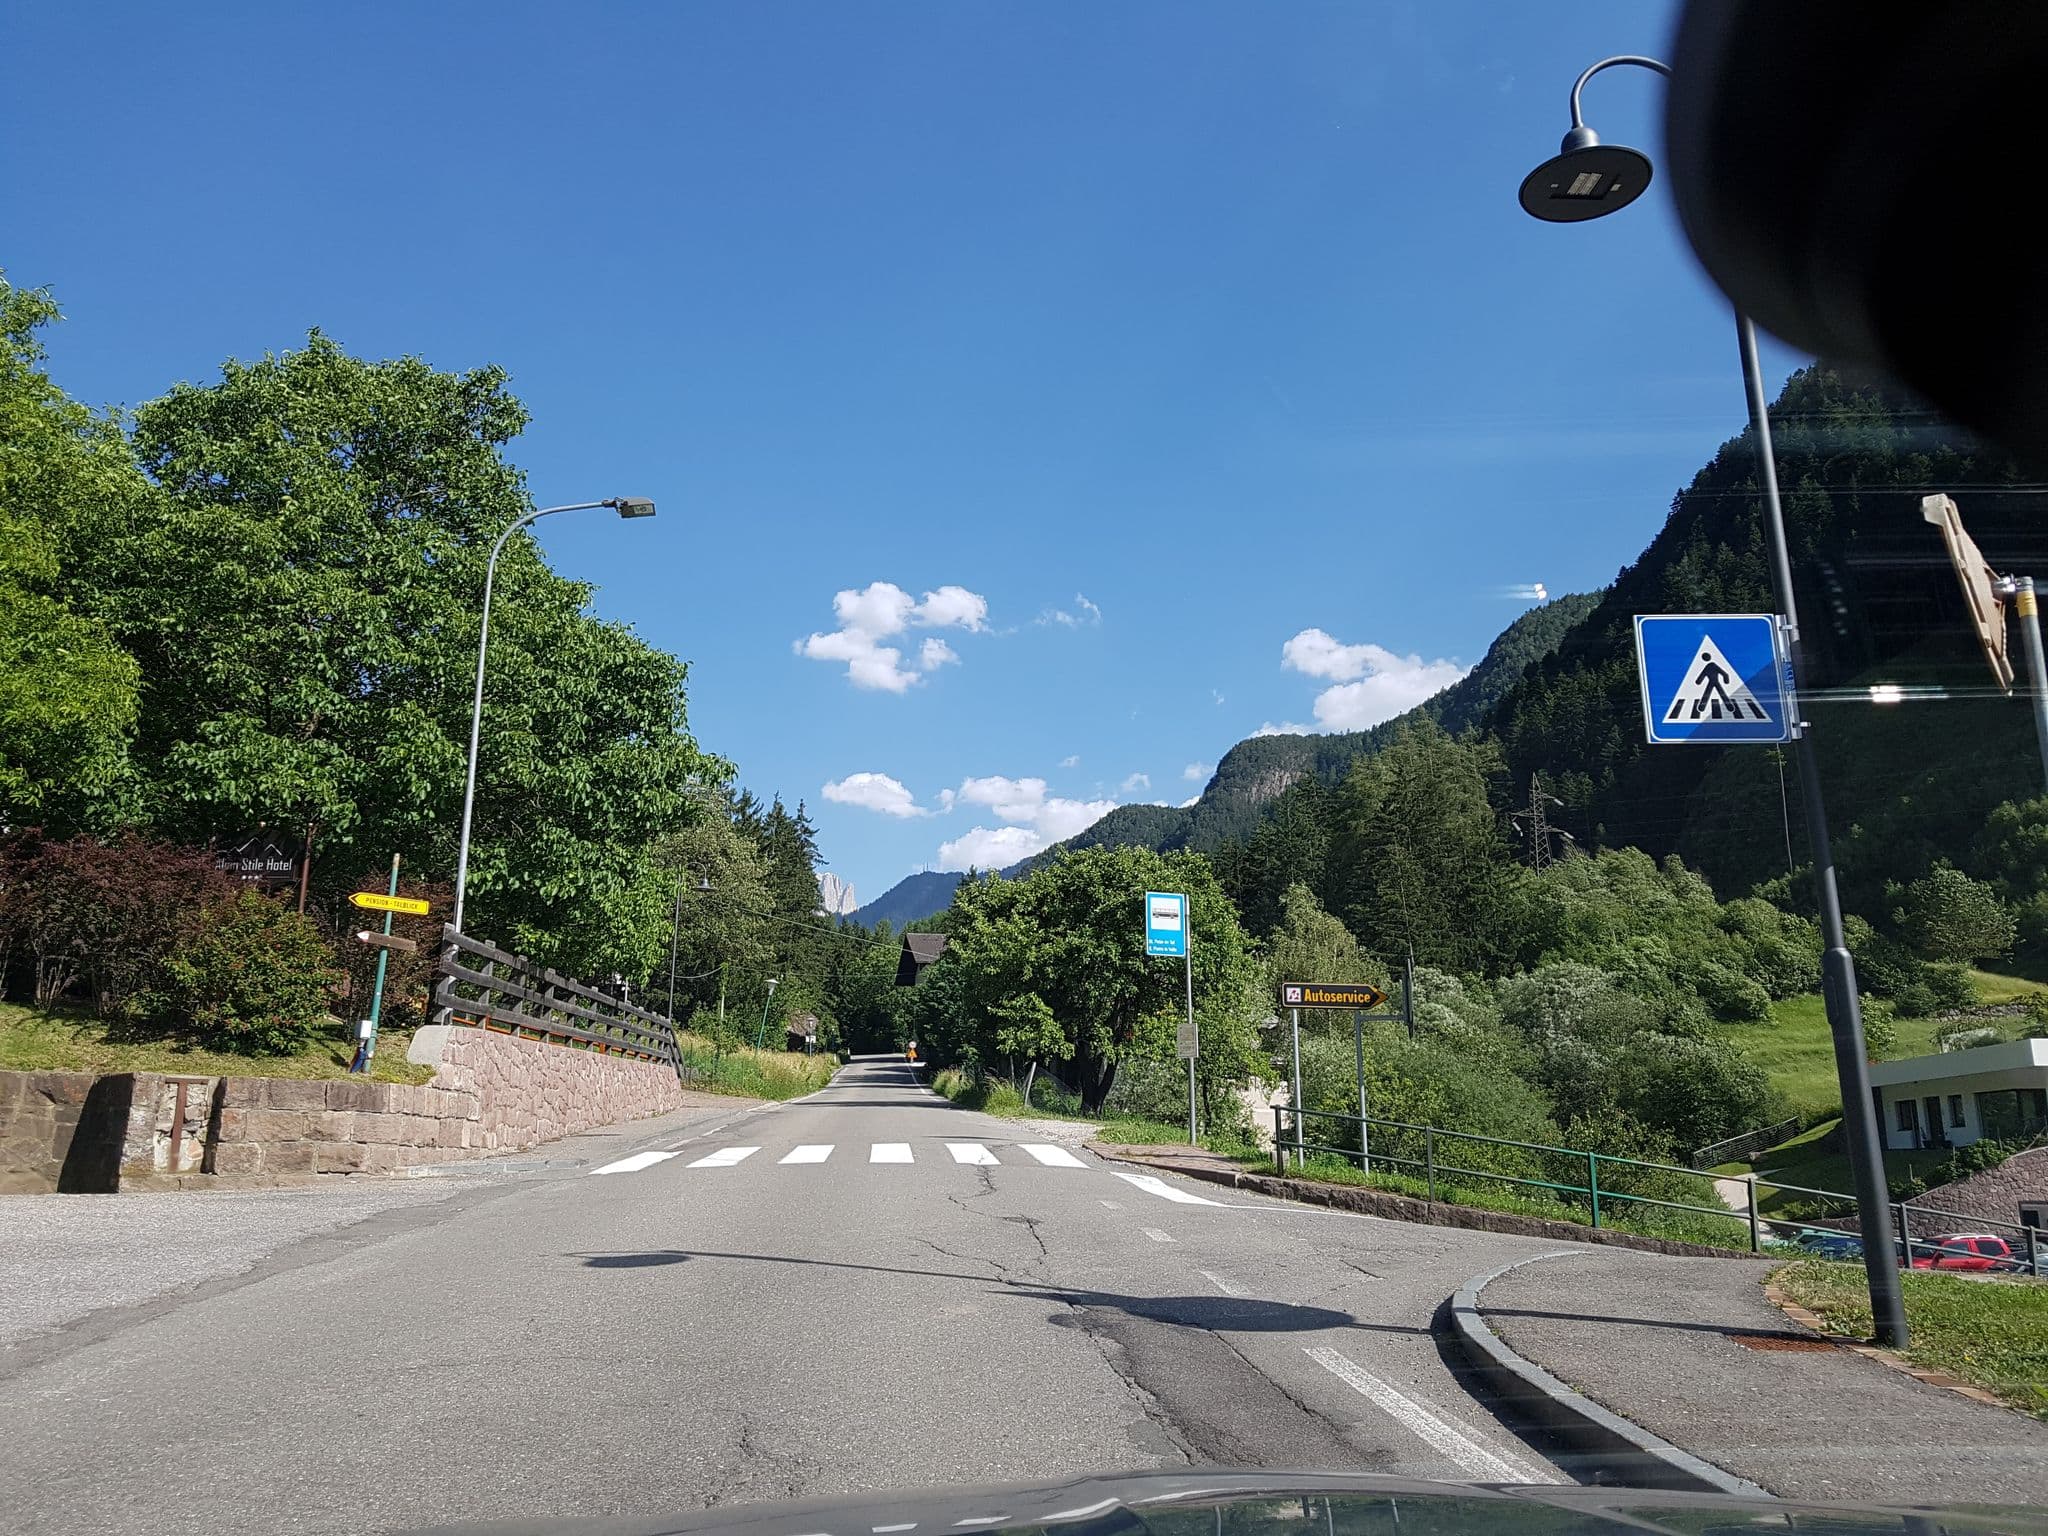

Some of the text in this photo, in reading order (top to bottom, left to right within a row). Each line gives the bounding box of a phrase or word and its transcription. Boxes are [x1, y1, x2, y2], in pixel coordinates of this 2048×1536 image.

[241, 857, 263, 871] Stile
[266, 857, 293, 871] Hotel
[1304, 988, 1371, 1003] Autoservice
